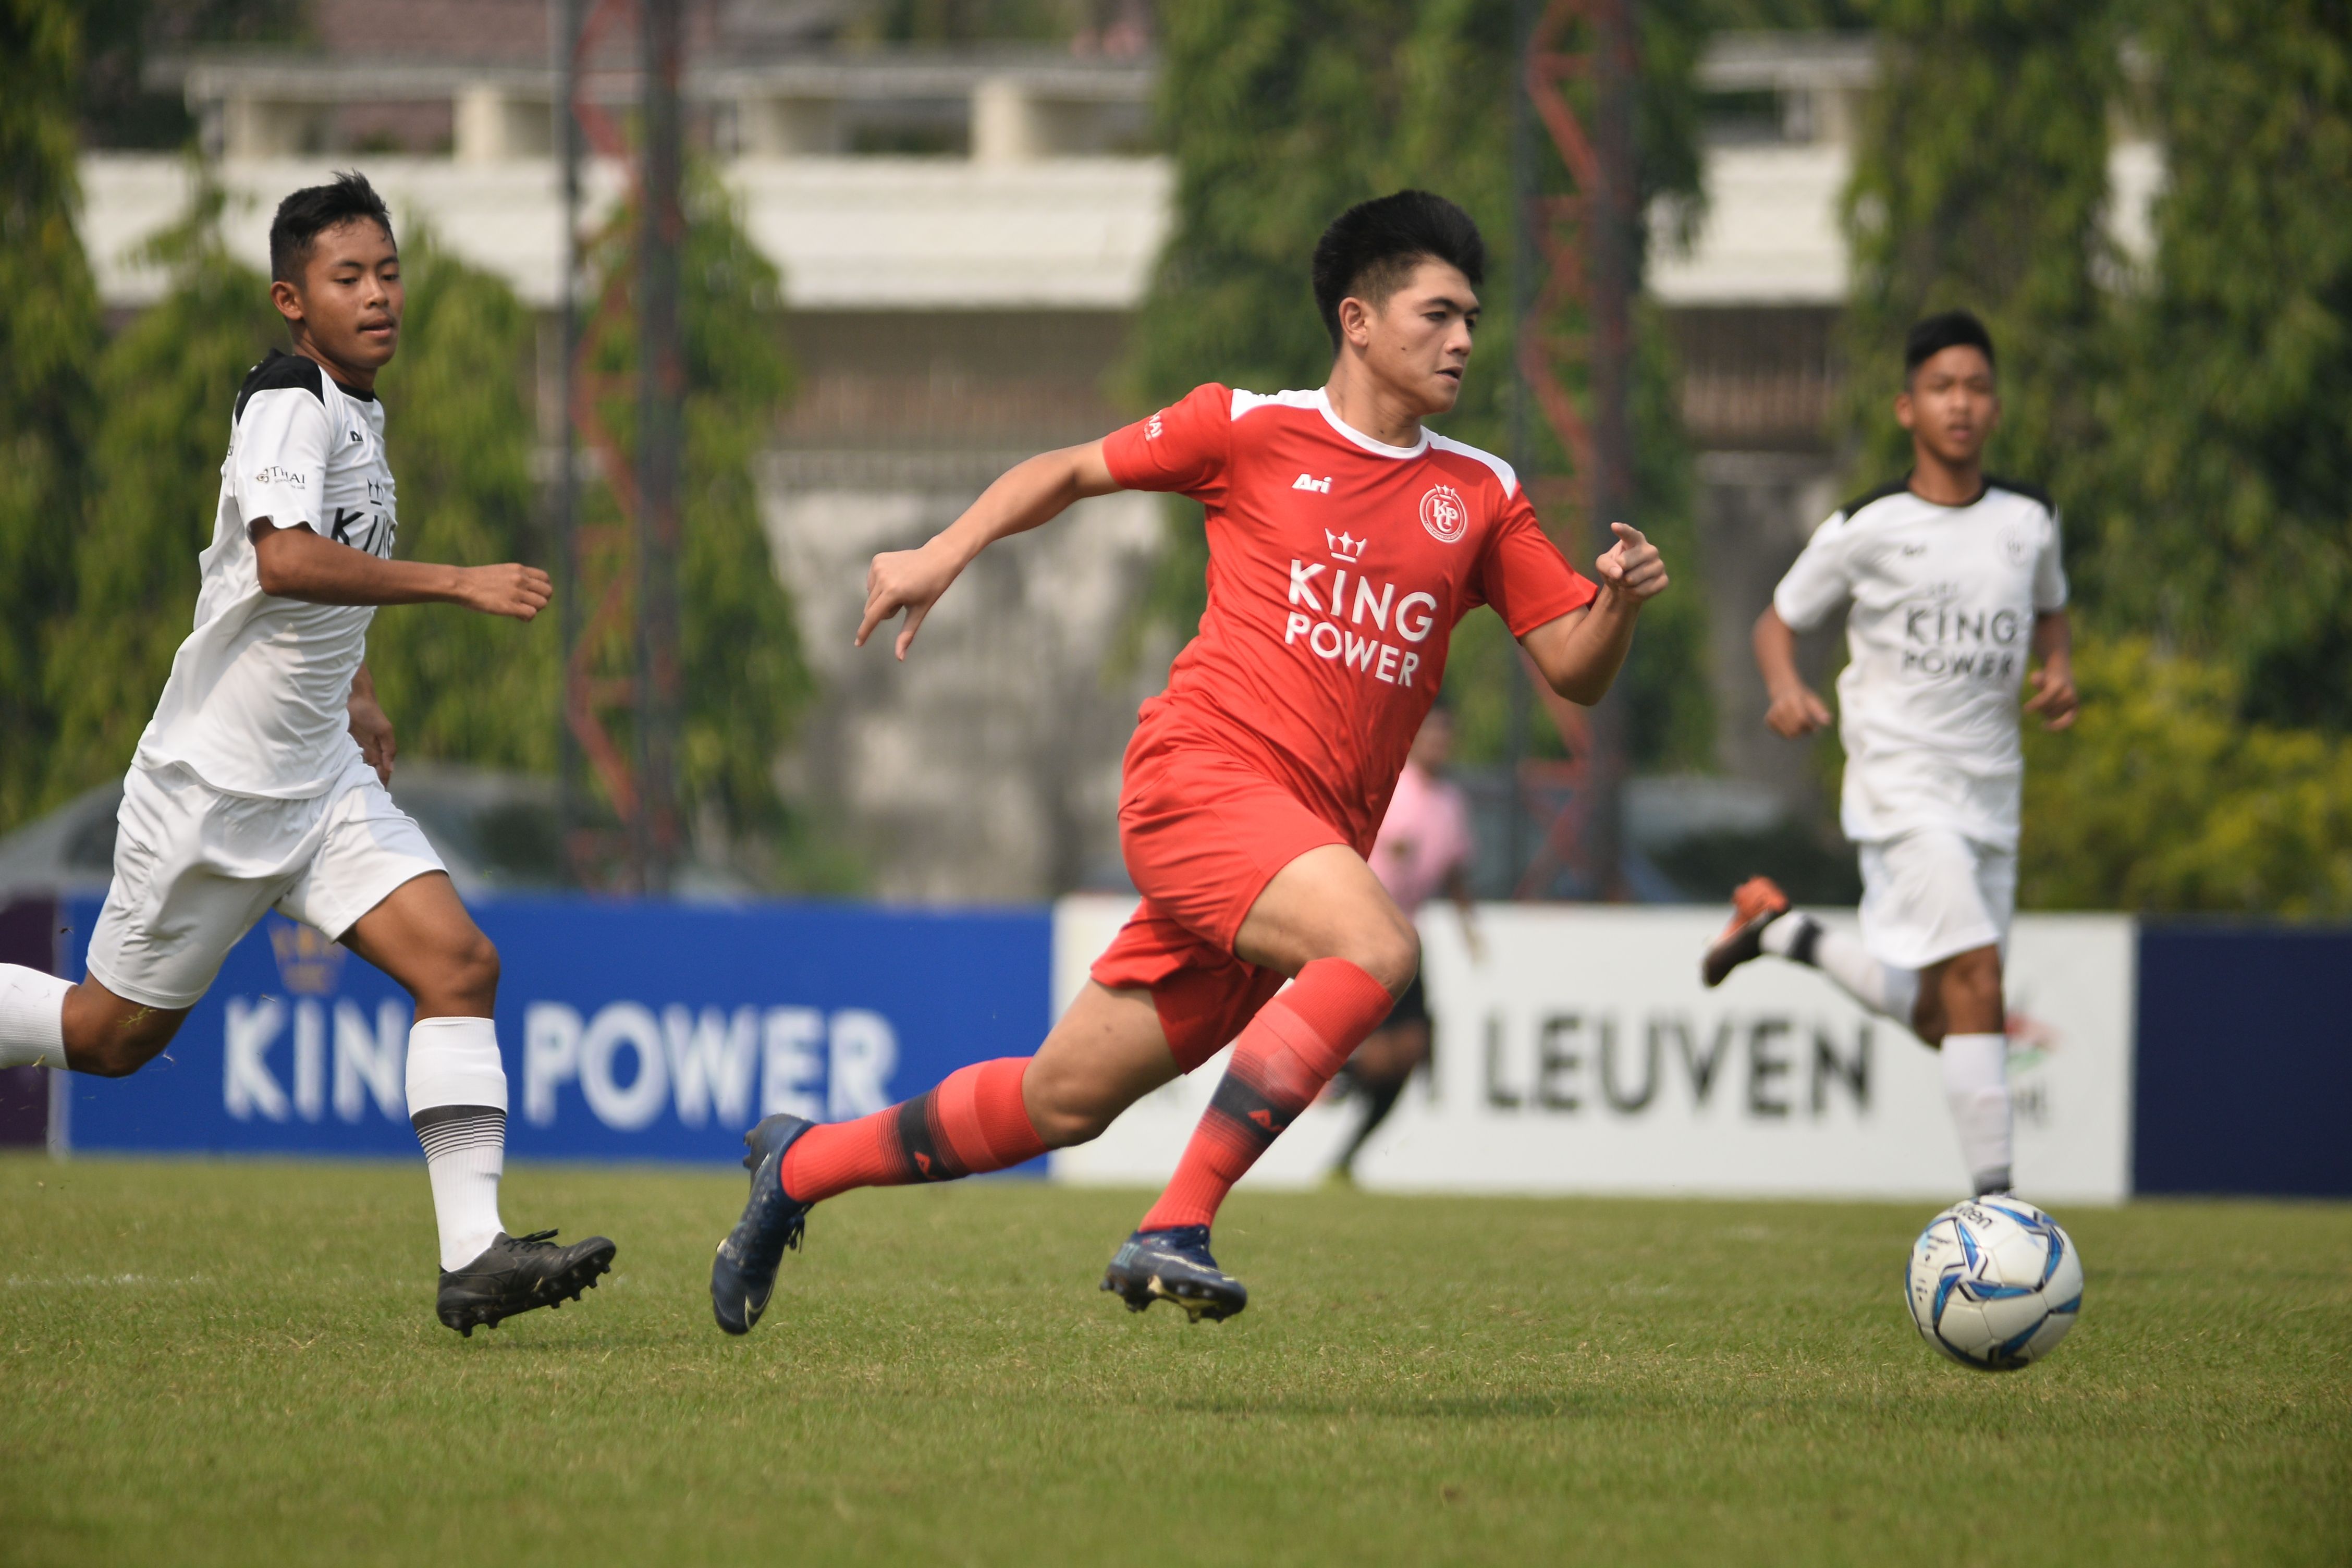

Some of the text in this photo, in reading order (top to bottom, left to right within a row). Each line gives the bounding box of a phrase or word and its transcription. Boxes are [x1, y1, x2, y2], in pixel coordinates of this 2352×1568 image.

[1148, 413, 1163, 439] HAI
[271, 466, 305, 484] THAI
[1292, 473, 1332, 494] Ari
[1288, 559, 1437, 642] KING
[1905, 607, 2018, 645] KING
[1284, 611, 1420, 688] POWER
[1903, 649, 2015, 677] POWER
[223, 995, 902, 1133] KIN POWER
[1481, 1012, 1876, 1119] LEUVEN
